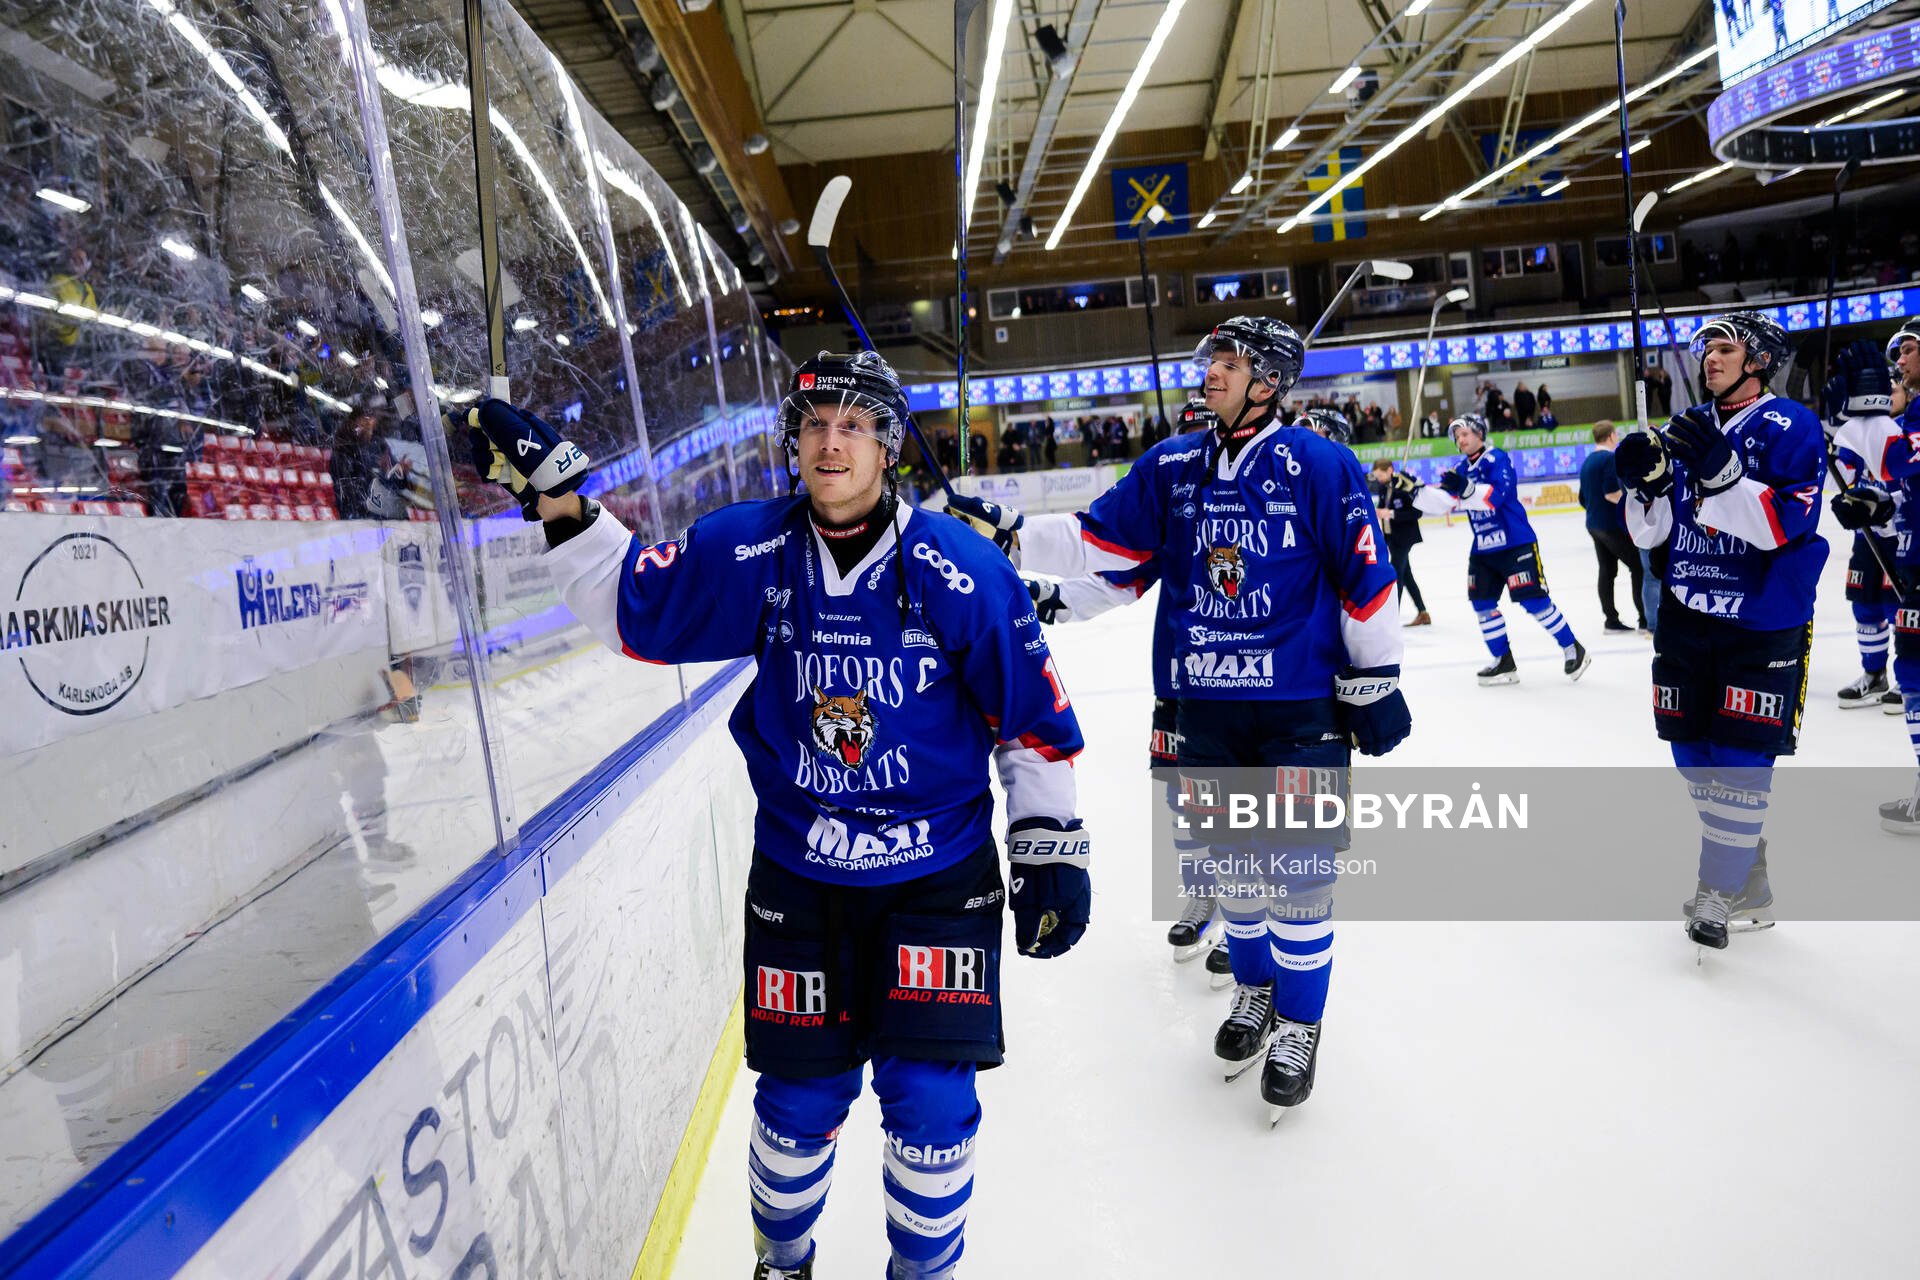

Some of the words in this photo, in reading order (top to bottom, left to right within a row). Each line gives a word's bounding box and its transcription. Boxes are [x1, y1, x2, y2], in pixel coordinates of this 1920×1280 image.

[817, 376, 857, 385] SVENSKA
[1158, 448, 1202, 466] Swegon
[1203, 502, 1246, 513] Helmia
[1282, 520, 1297, 549] A
[72, 544, 98, 560] 2021
[1355, 524, 1378, 564] 4
[1688, 564, 1720, 573] AUTO
[1188, 583, 1272, 619] BOBCATS
[1709, 589, 1745, 597] KARLSKOGA
[826, 613, 862, 622] BAUER
[812, 630, 872, 646] Helmia
[1185, 652, 1274, 678] MAXI
[58, 677, 119, 704] KARLSKOGA
[119, 665, 133, 683] AB
[794, 651, 904, 708] BOFORS
[1200, 677, 1274, 688] STORMARKNAD
[1336, 681, 1391, 696] AUER
[794, 740, 910, 794] BOBCATS
[807, 814, 930, 860] MAXI
[1012, 840, 1090, 856] BAUE
[805, 850, 826, 865] ICA
[827, 845, 934, 870] STORMARKNAD
[750, 902, 785, 924] AUER
[888, 988, 932, 1003] ROAD
[936, 991, 993, 1006] RENTAL
[751, 1008, 785, 1024] ROAD
[888, 1130, 976, 1165] Helmia
